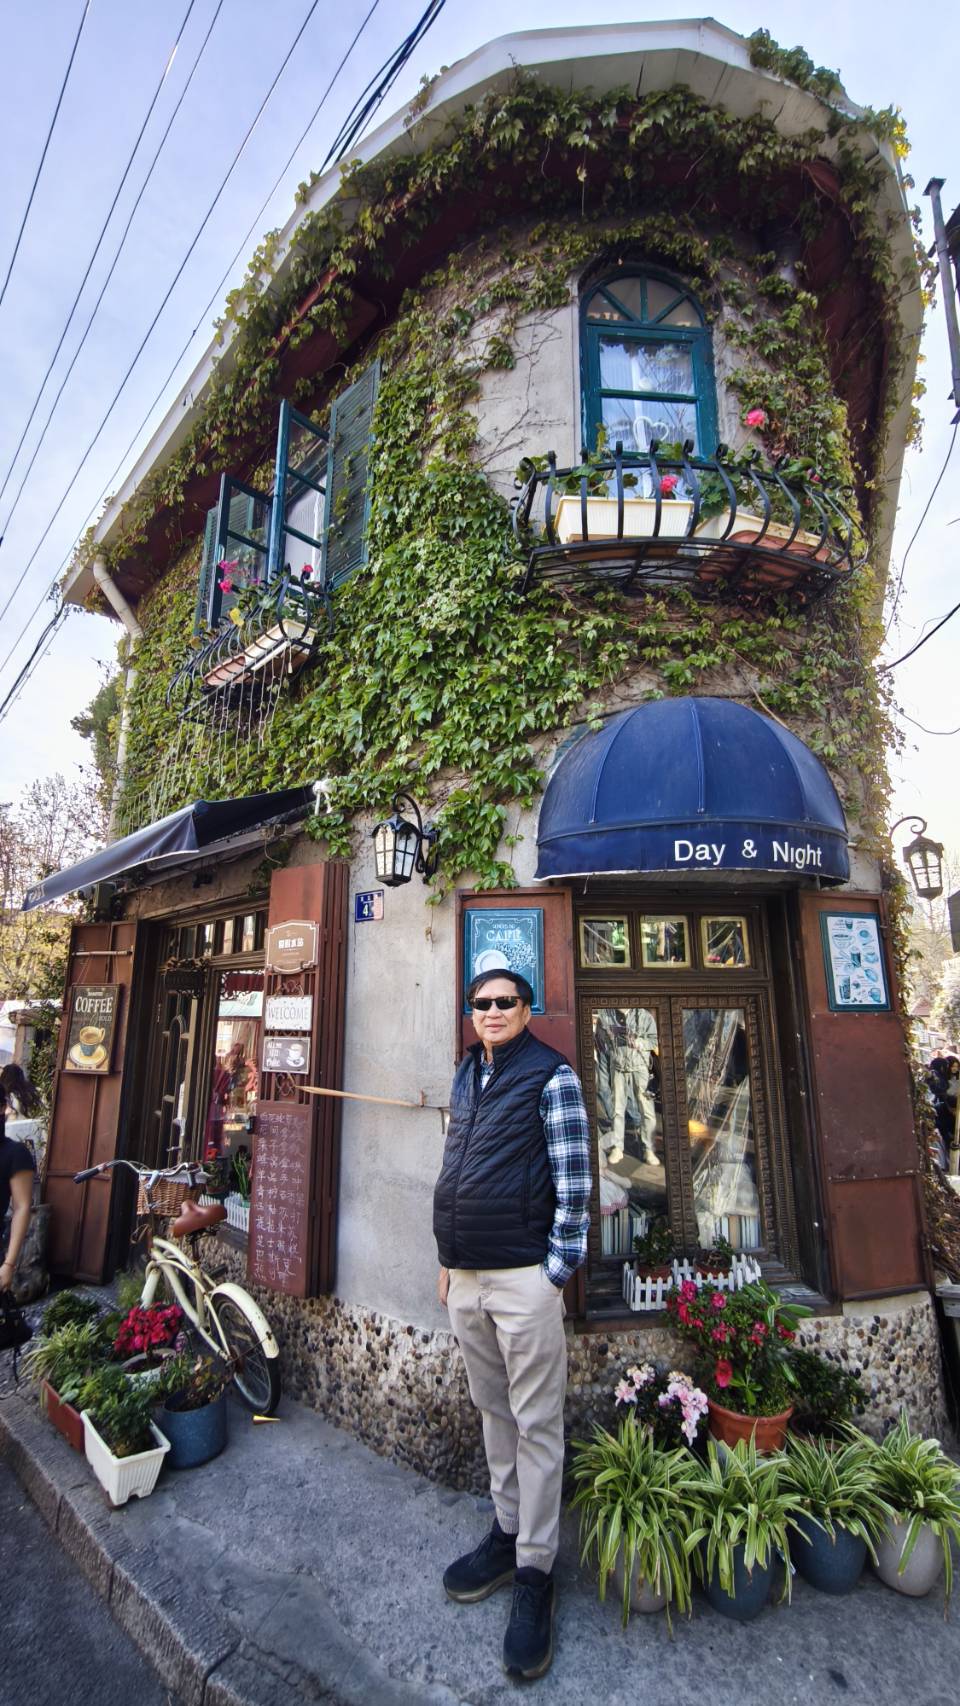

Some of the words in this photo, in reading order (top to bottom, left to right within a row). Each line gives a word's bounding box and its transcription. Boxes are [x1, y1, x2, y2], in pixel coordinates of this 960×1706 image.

[674, 840, 726, 866] Day
[742, 839, 758, 859] &
[772, 841, 822, 869] Night
[75, 996, 113, 1013] COFFEE
[268, 1007, 308, 1020] WELCOME
